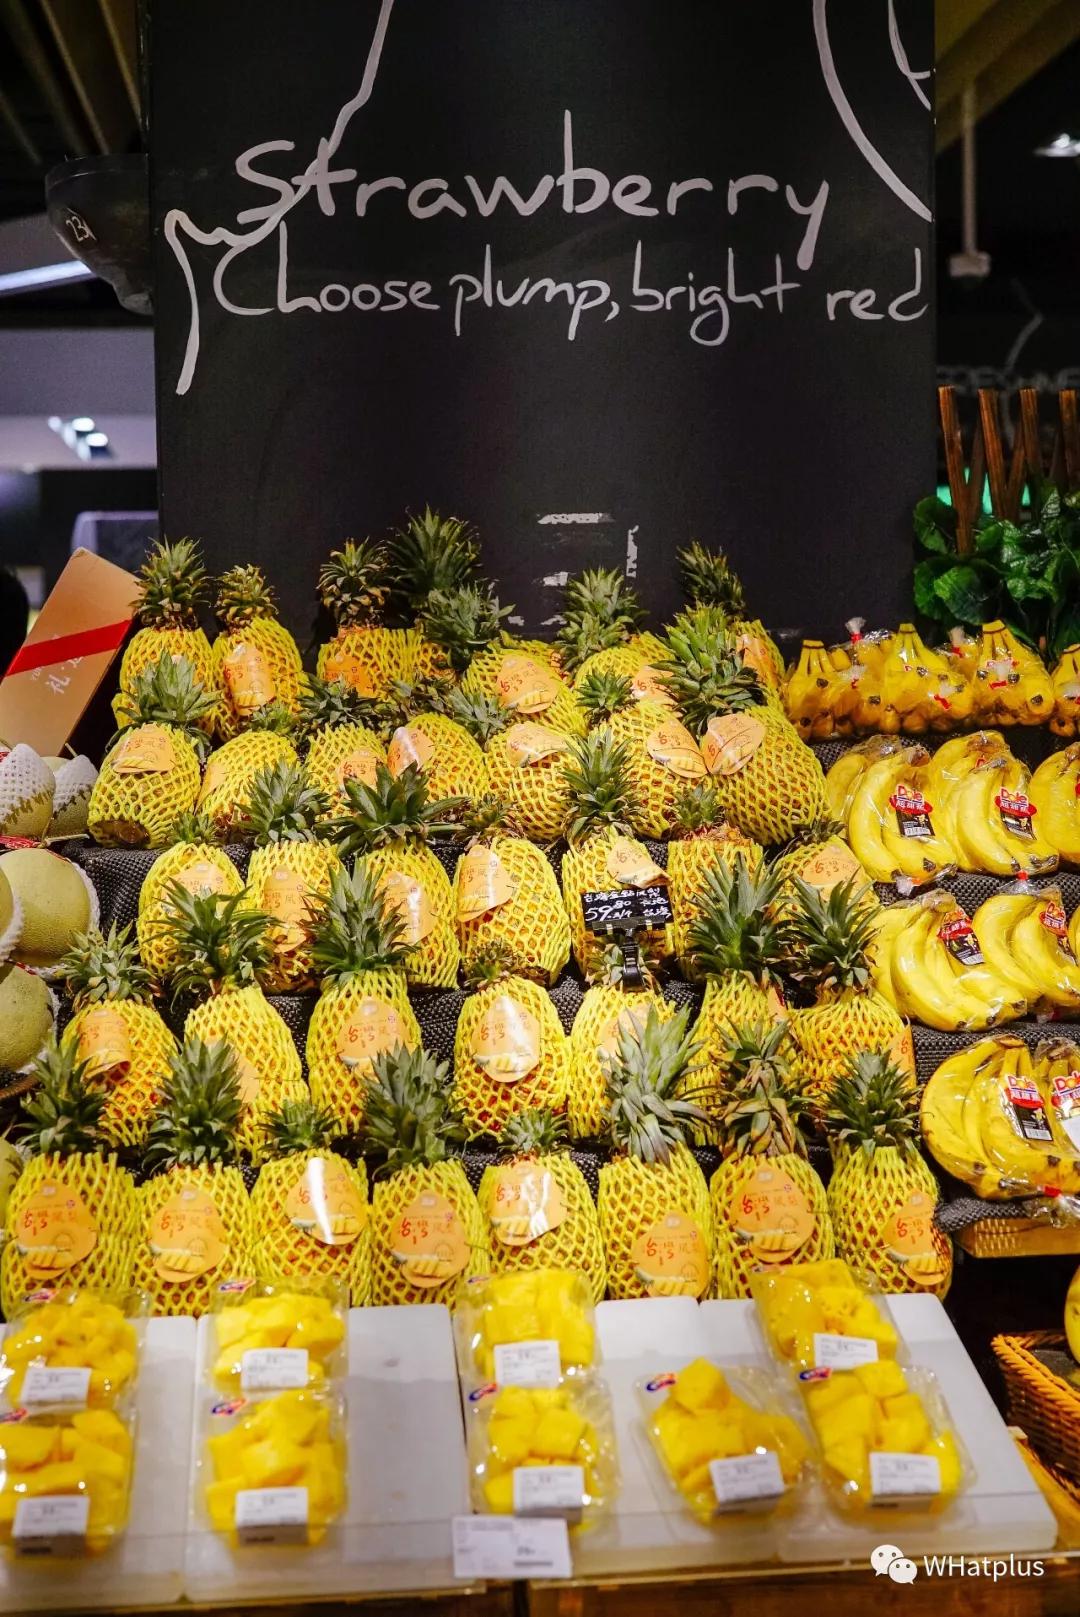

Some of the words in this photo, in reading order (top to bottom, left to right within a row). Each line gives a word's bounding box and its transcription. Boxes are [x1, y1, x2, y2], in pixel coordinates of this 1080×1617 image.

[234, 109, 829, 270] Strawberry
[213, 220, 440, 316] Choose
[449, 243, 620, 341] plump,
[630, 239, 801, 347] bright
[826, 247, 929, 322] red
[1001, 788, 1028, 803] Dole
[1008, 1075, 1037, 1090] Dole
